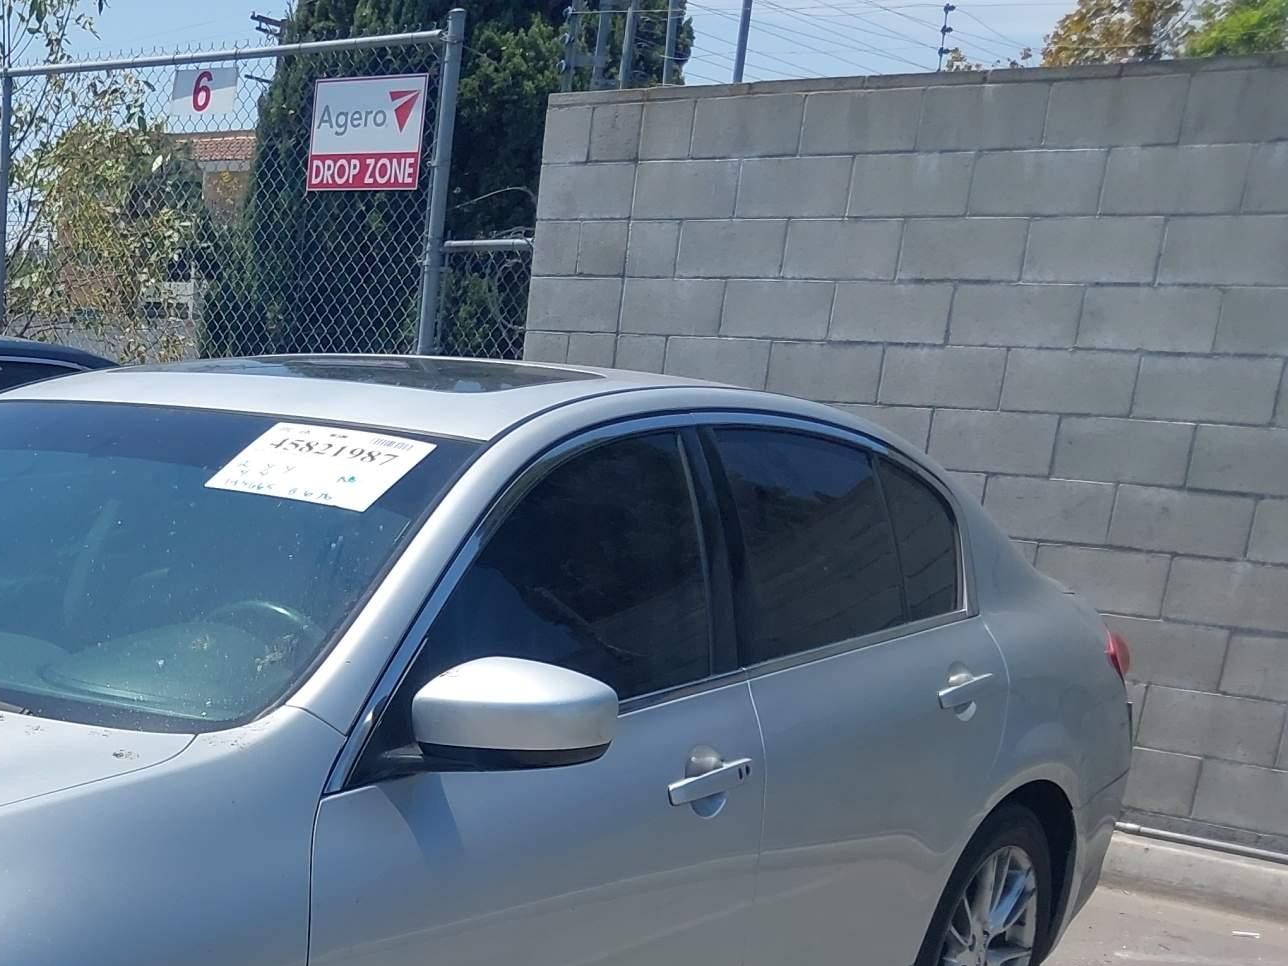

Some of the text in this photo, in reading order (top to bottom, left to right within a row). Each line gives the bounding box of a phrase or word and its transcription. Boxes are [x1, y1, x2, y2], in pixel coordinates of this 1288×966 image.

[192, 70, 214, 113] 6
[316, 104, 388, 137] Agero
[311, 157, 416, 185] DROP ZONE
[269, 438, 399, 466] 45821987
